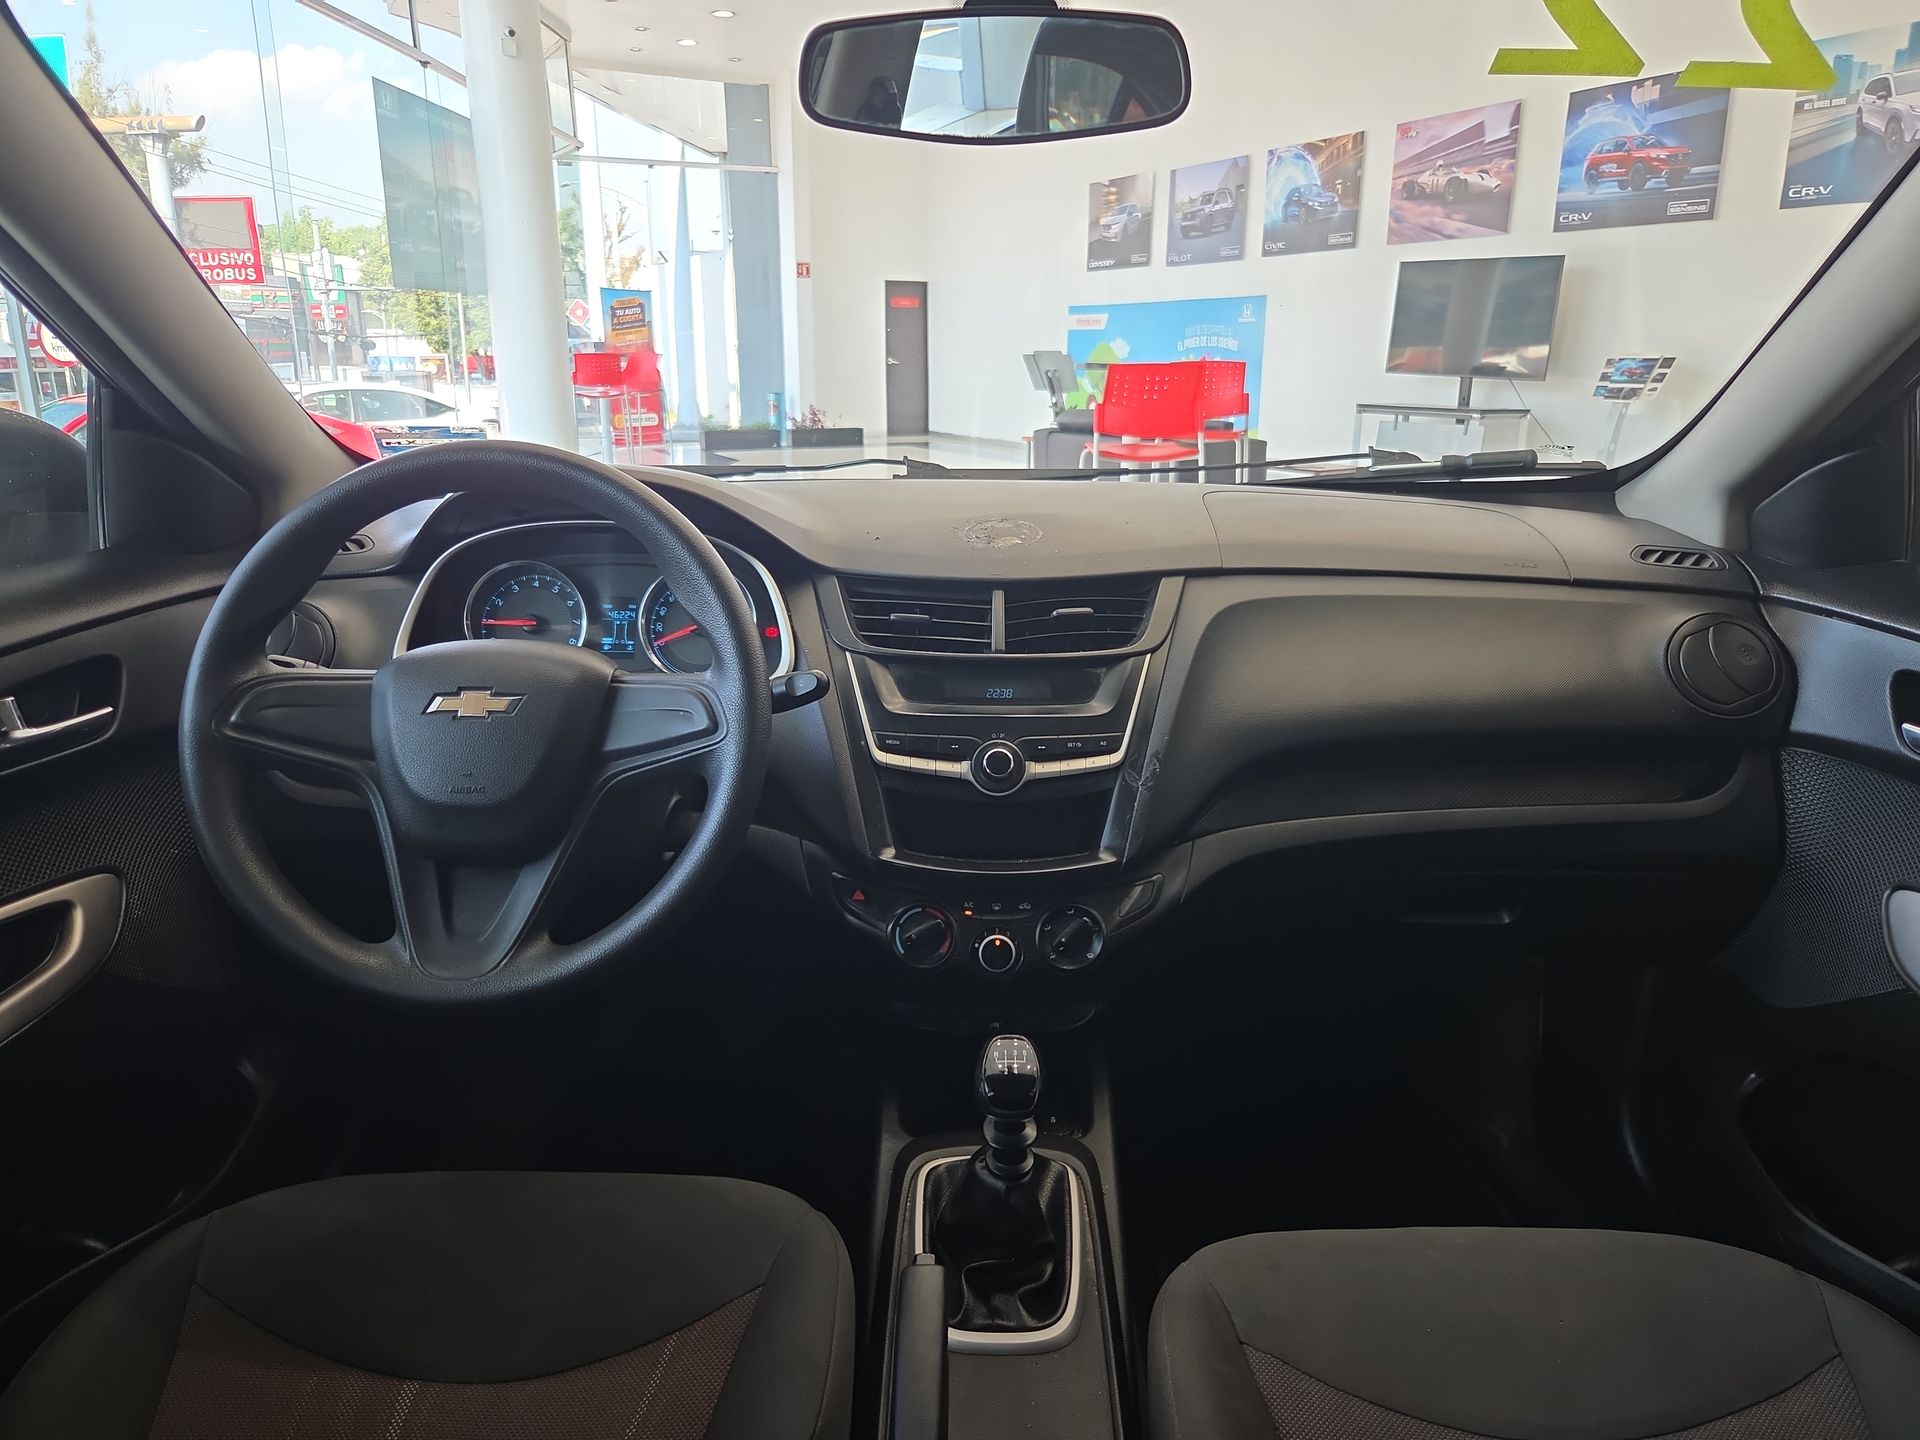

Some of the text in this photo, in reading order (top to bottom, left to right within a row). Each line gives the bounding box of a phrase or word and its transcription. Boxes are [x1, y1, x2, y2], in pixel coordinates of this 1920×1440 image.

[1788, 184, 1834, 197] CR-V
[1560, 212, 1593, 223] CR-V
[1264, 241, 1286, 250] CIVIC
[1168, 253, 1193, 263] PILOT
[1088, 259, 1116, 269] ODYSSEY
[625, 307, 642, 315] AUTO
[1183, 336, 1200, 350] PODER
[1200, 336, 1209, 347] DE
[1207, 336, 1218, 347] LOS
[512, 584, 520, 593] 3
[552, 586, 561, 594] 5
[495, 598, 504, 607] 2
[608, 610, 637, 619] 46224
[660, 606, 668, 617] 40
[656, 622, 664, 632] 20
[1003, 1067, 1009, 1075] 2
